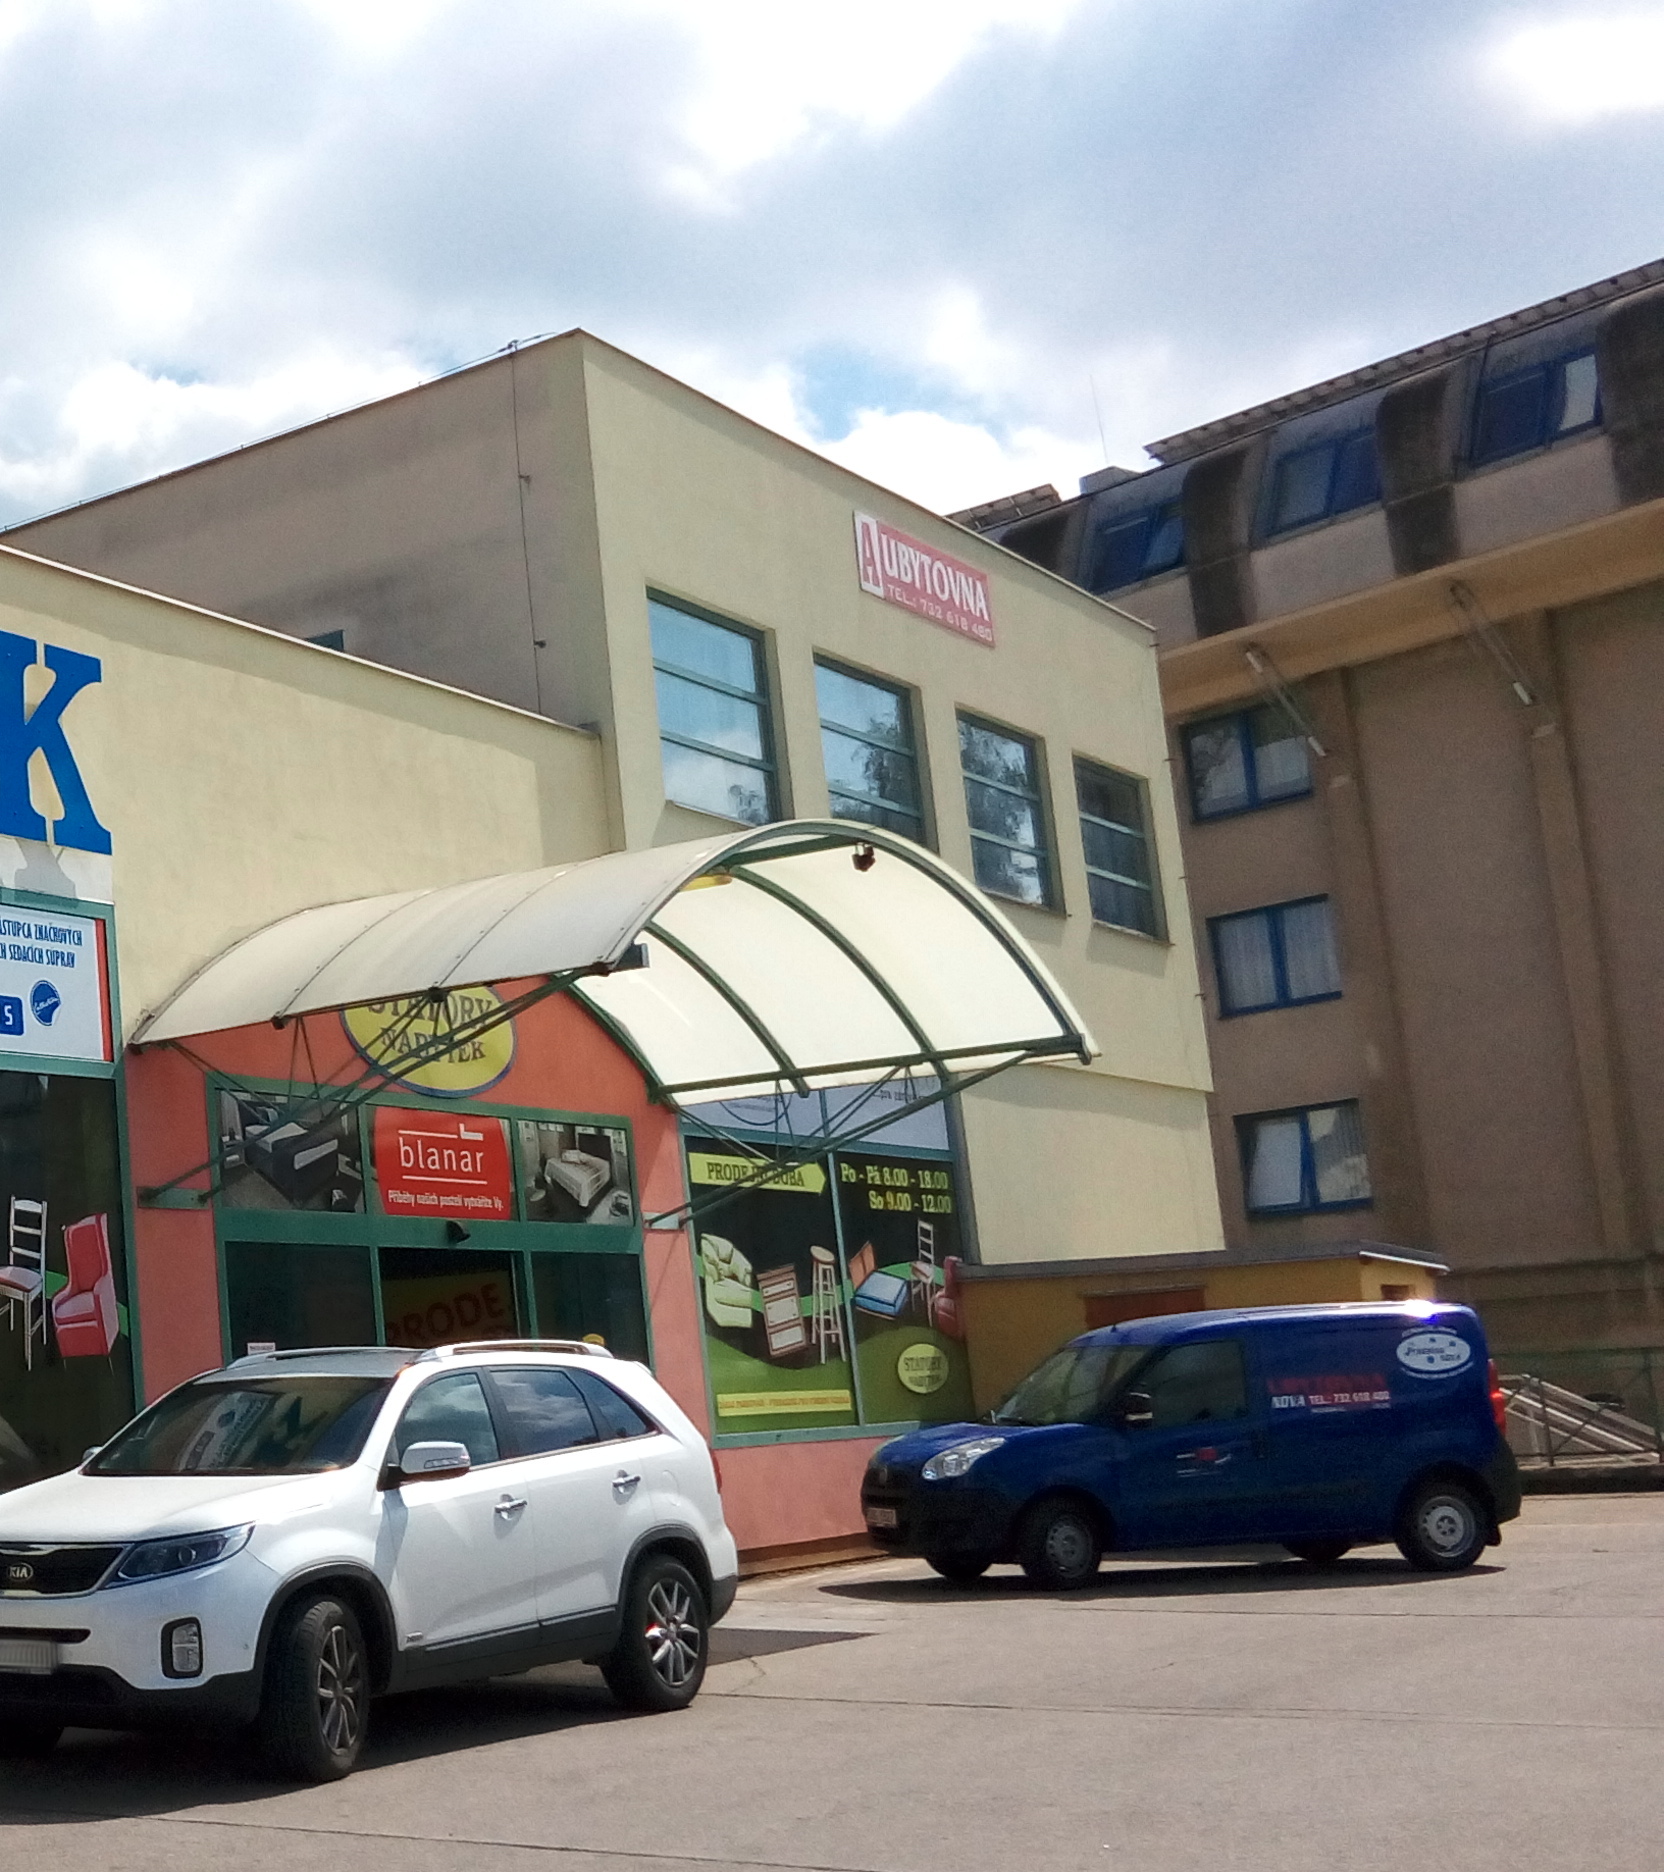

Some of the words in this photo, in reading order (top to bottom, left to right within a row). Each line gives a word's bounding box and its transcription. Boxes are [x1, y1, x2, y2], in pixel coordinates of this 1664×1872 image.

[920, 598, 943, 620] 732
[398, 1136, 485, 1173] blanar
[839, 1162, 856, 1183] Po
[865, 1165, 882, 1184] Pá
[882, 1166, 909, 1187] 8.00
[917, 1170, 949, 1190] 18.00
[868, 1190, 884, 1210] So
[885, 1190, 912, 1211] 9.00
[921, 1194, 952, 1214] 12.00
[9, 1566, 29, 1579] KIA
